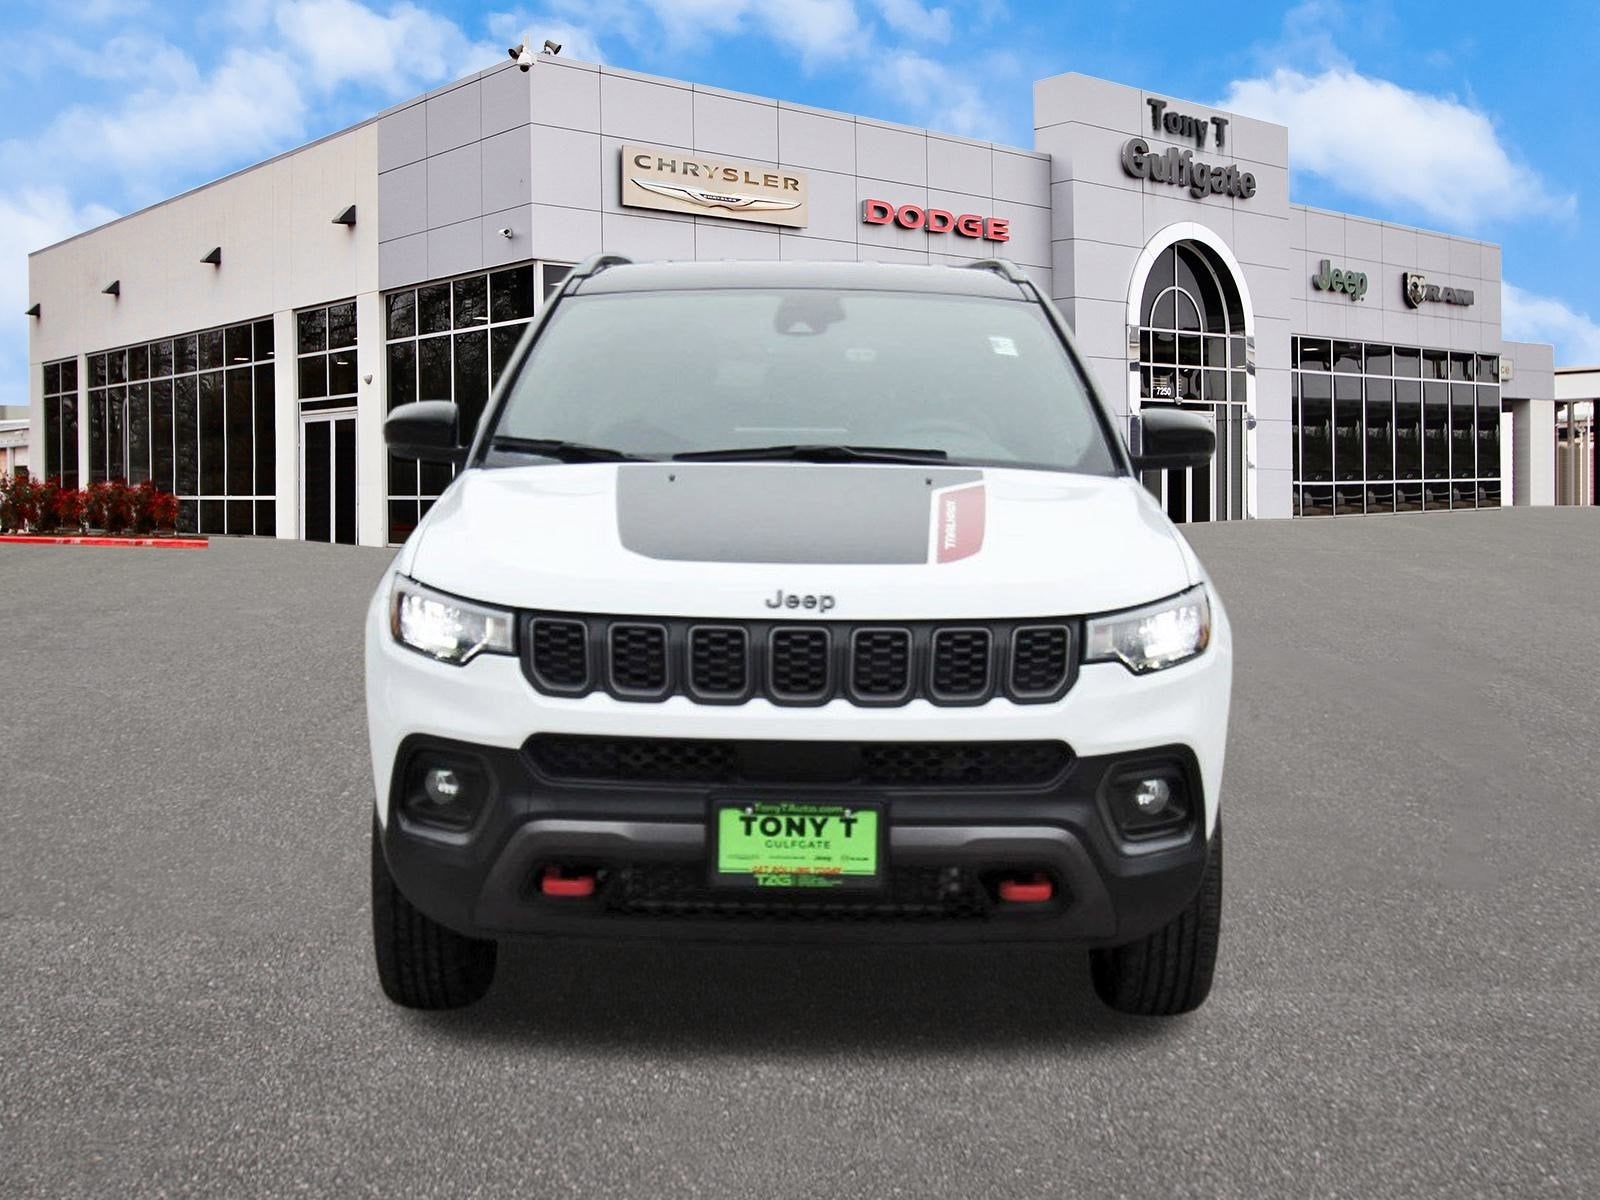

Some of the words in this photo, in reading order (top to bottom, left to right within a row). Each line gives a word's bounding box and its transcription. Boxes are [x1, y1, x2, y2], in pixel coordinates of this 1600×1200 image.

[1146, 97, 1208, 148] Tony
[1210, 116, 1229, 147] T
[633, 154, 800, 192] CHRYSLER
[1121, 137, 1256, 199] Gulfgate
[863, 198, 1010, 242] DODGE
[1312, 259, 1368, 302] Jeep
[1425, 284, 1475, 306] RAM
[765, 589, 836, 613] Jeep
[739, 816, 828, 838] TONY
[839, 817, 858, 838] T
[764, 840, 831, 849] GULFGATE
